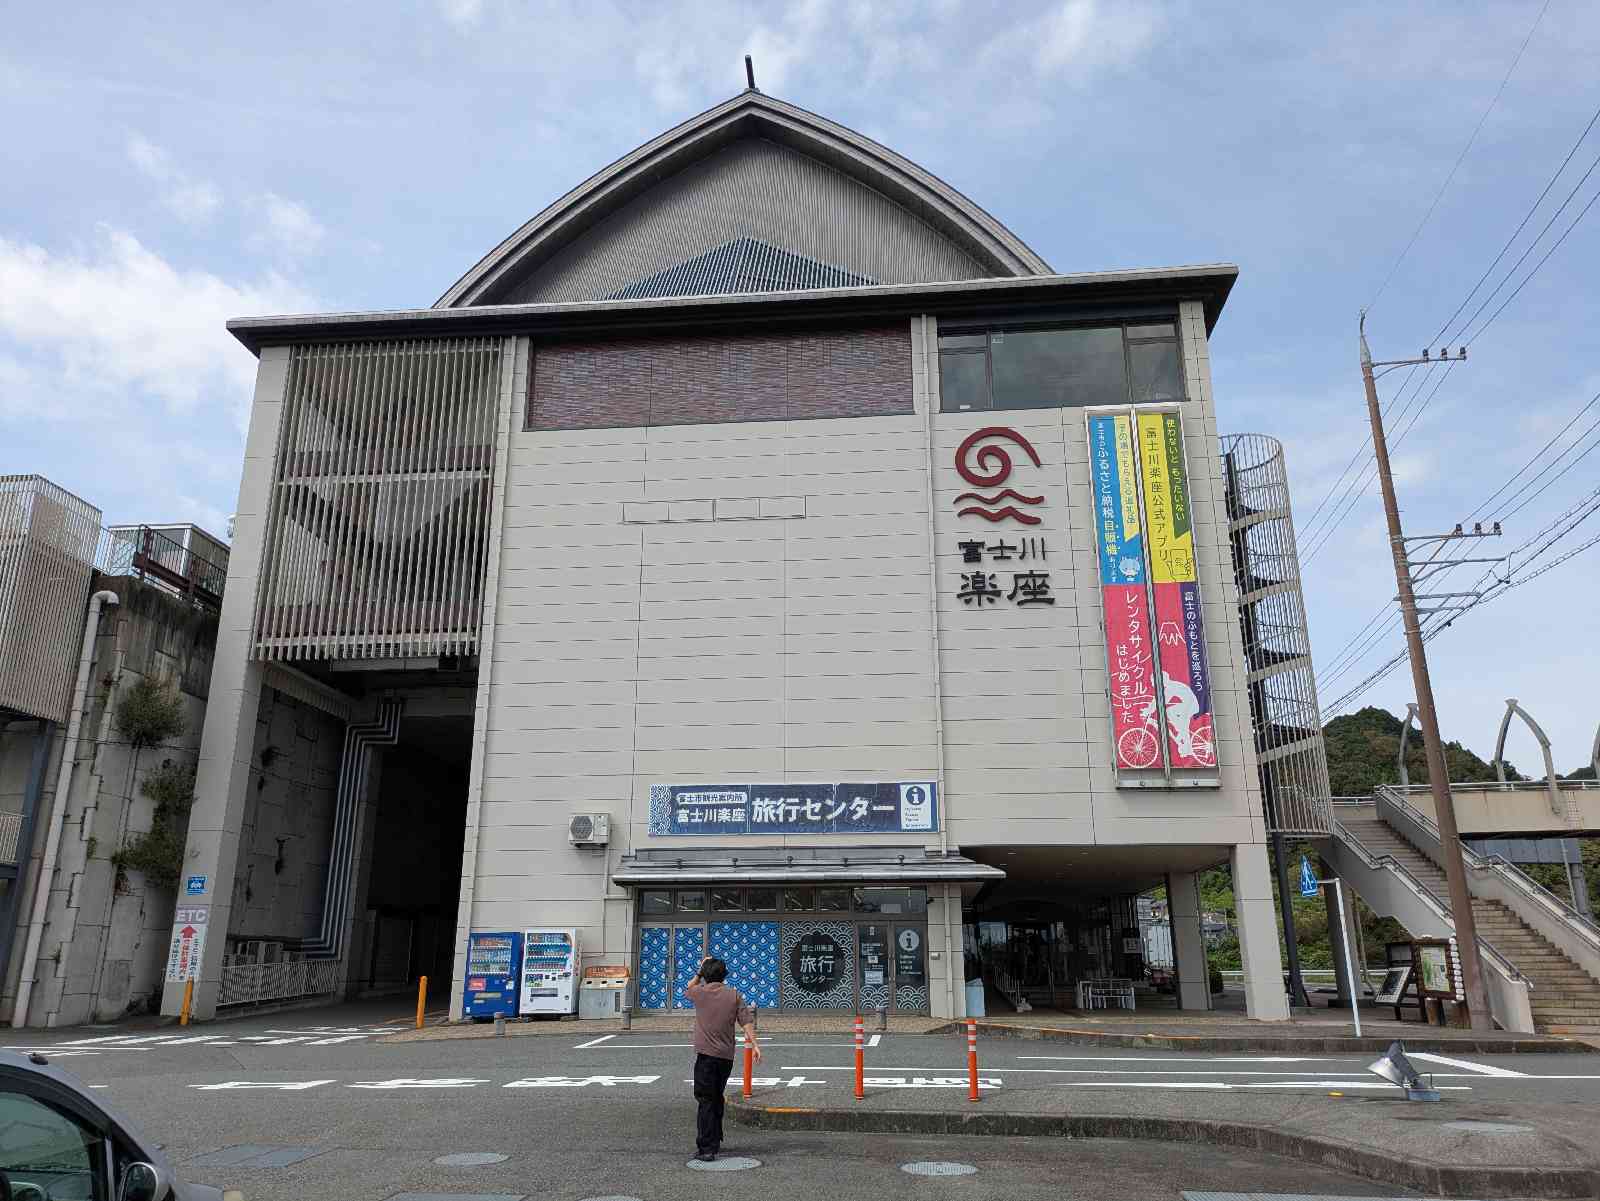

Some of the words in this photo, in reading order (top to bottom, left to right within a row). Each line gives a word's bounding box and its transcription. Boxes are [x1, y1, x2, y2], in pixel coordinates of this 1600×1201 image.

[1144, 427, 1168, 561] 富士川楽座公式アプリ
[957, 538, 1046, 563] 富士川
[956, 569, 1056, 607] 楽座
[1126, 591, 1148, 695] レンタサイクル
[1116, 644, 1135, 723] はじめました
[678, 807, 746, 823] 富士川楽座
[751, 797, 896, 823] 旅行センター
[176, 909, 208, 922] ETC
[800, 955, 835, 973] 旅行
[801, 976, 836, 984] センター
